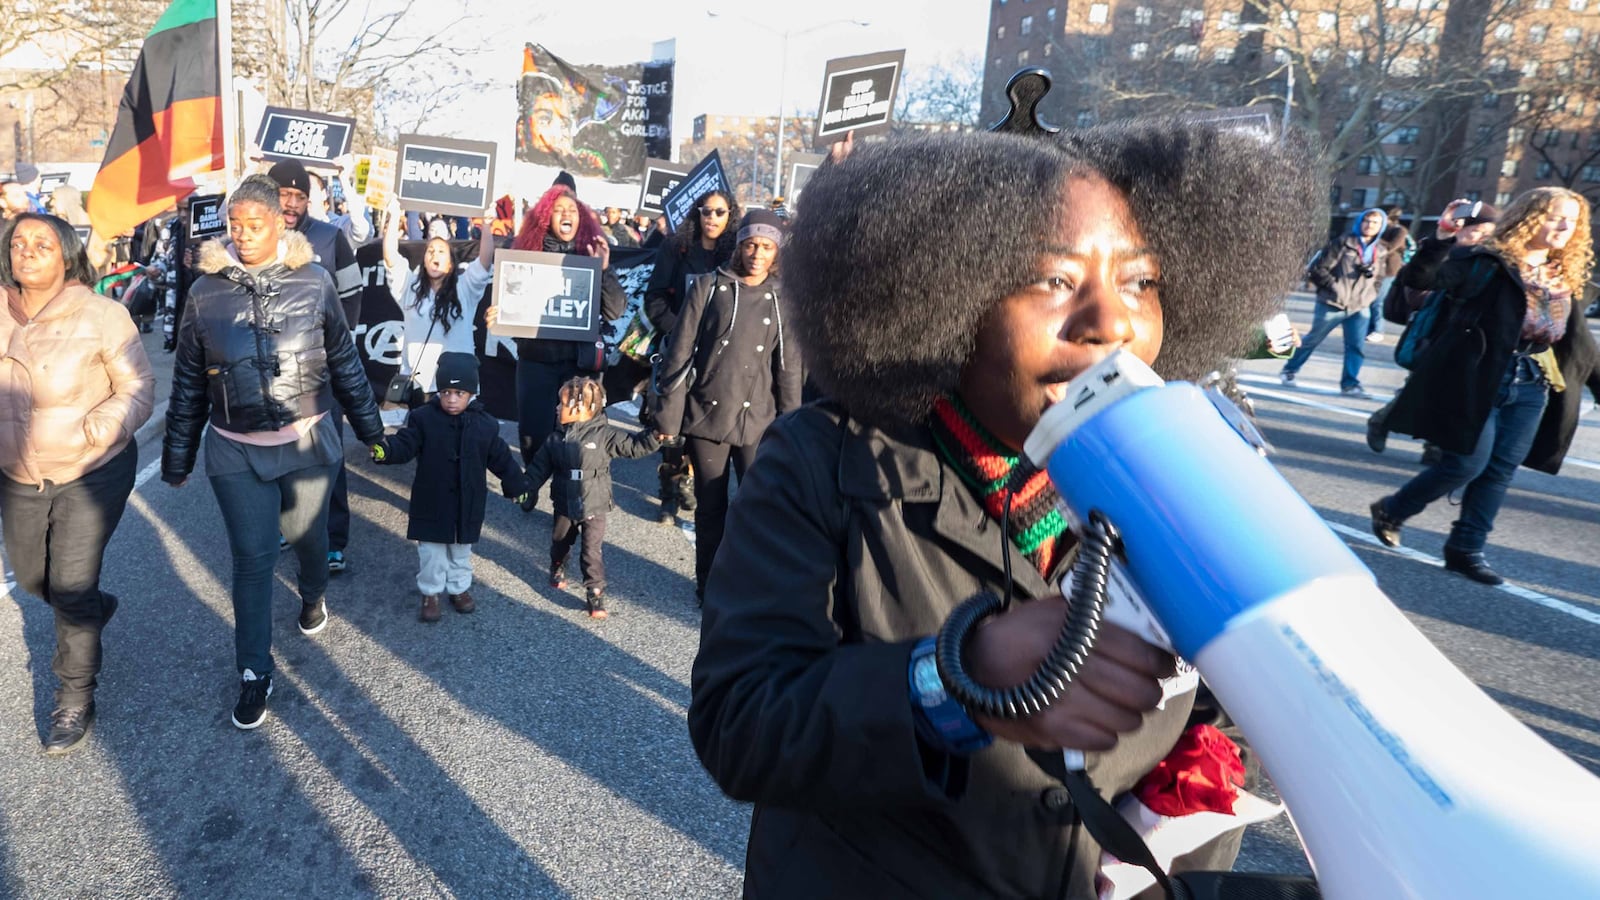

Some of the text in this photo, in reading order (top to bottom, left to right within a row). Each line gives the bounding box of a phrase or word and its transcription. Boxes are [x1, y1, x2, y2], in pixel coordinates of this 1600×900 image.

[626, 95, 648, 108] FOR
[621, 108, 650, 121] AKAI
[287, 119, 329, 136] NOT
[273, 139, 330, 158] MORE
[403, 159, 487, 189] ENOUGH
